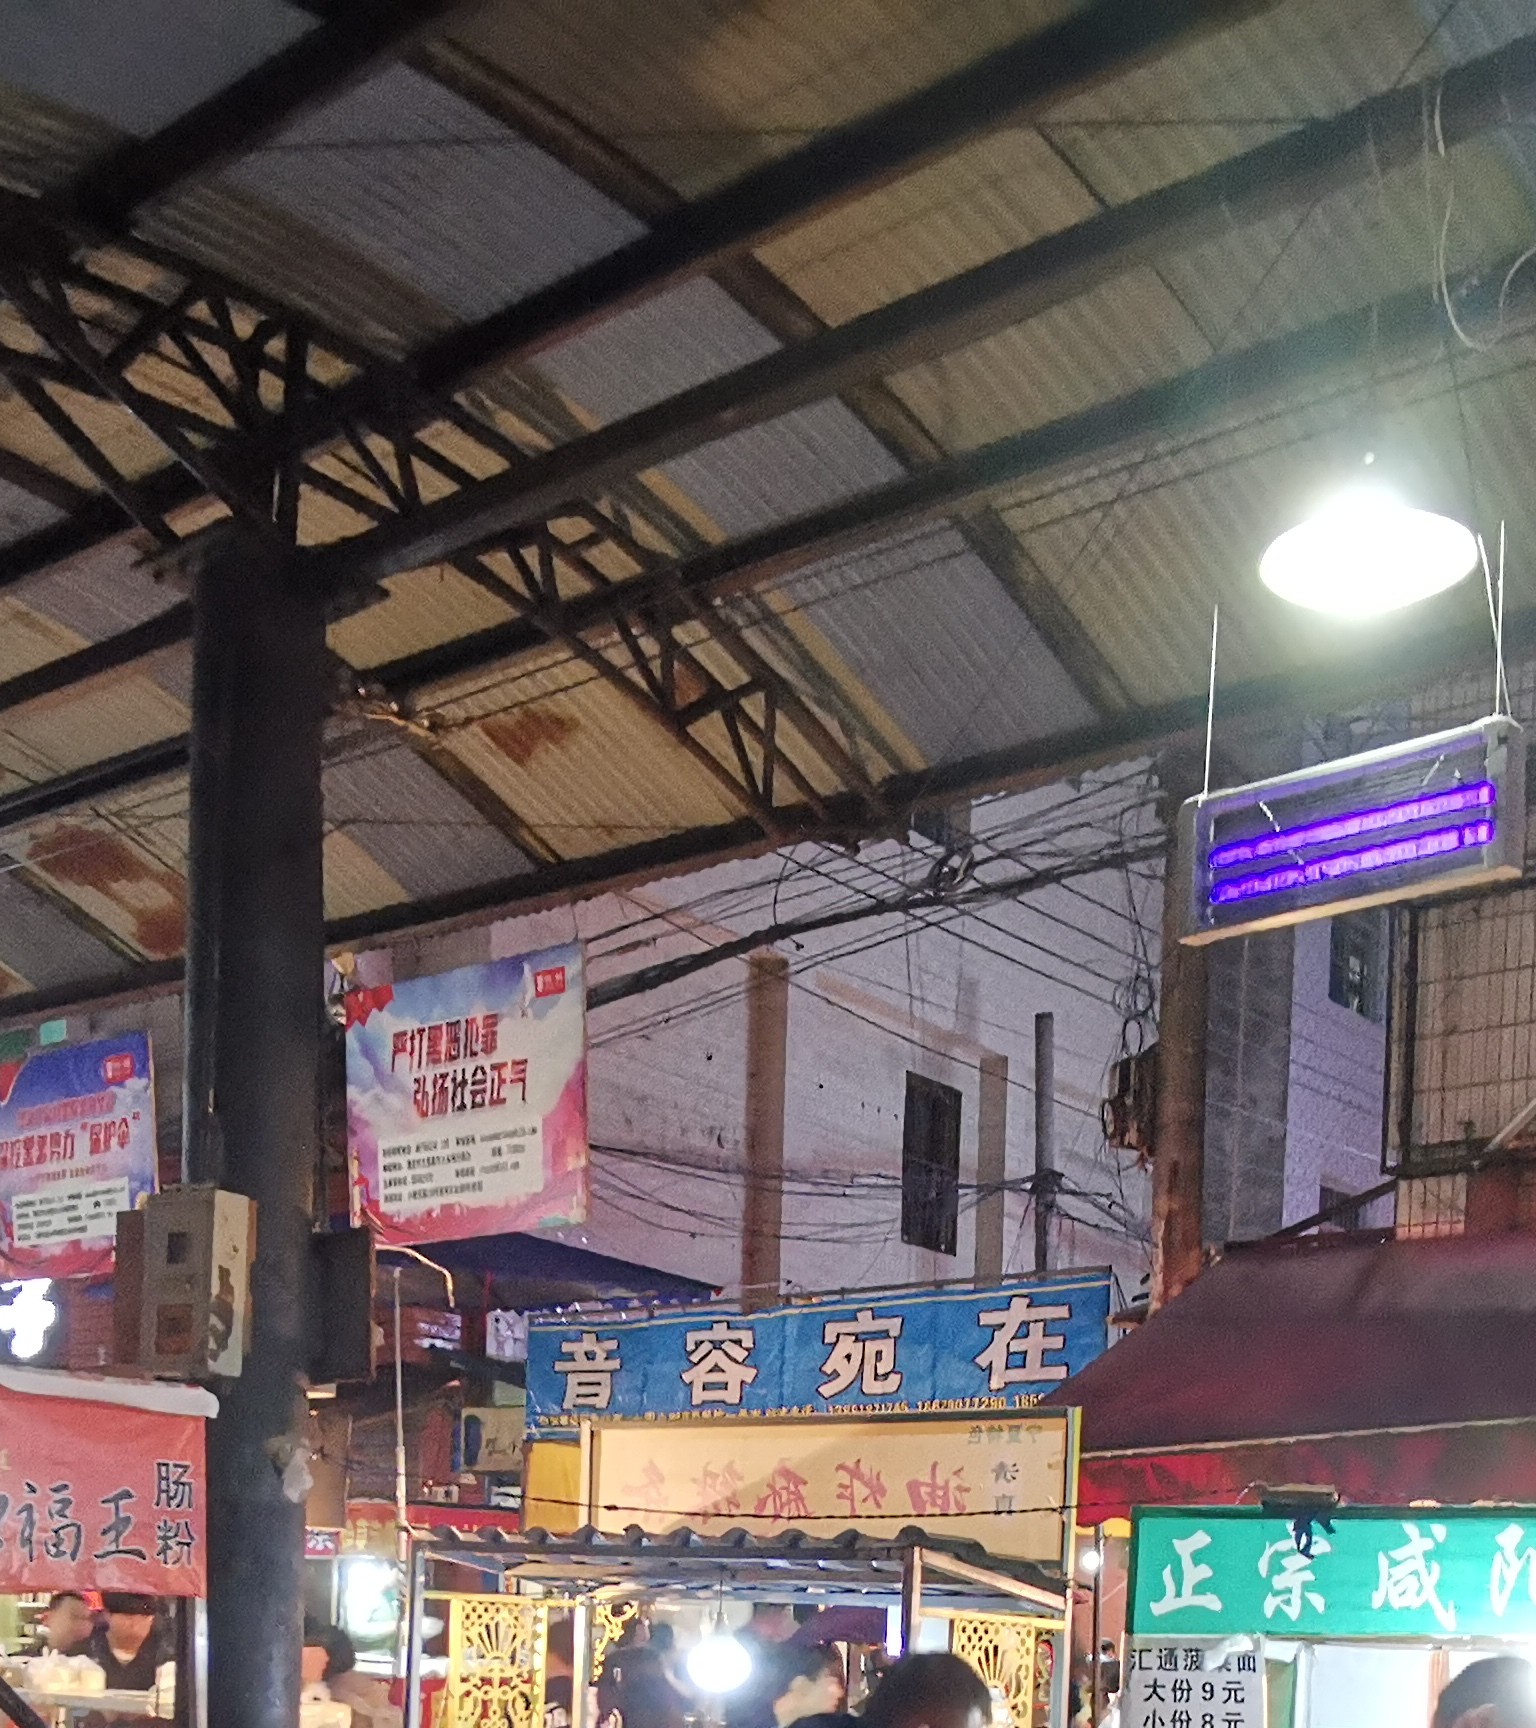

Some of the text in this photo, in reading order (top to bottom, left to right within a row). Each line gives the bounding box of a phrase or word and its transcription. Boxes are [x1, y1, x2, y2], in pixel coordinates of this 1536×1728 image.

[413, 1058, 528, 1119] 弘扬社会正气
[553, 1296, 1072, 1410] 音容宛在
[154, 1462, 194, 1566] 肠粉
[1131, 1647, 1257, 1673] 汇通菠面
[1143, 1677, 1245, 1704] 大份9元
